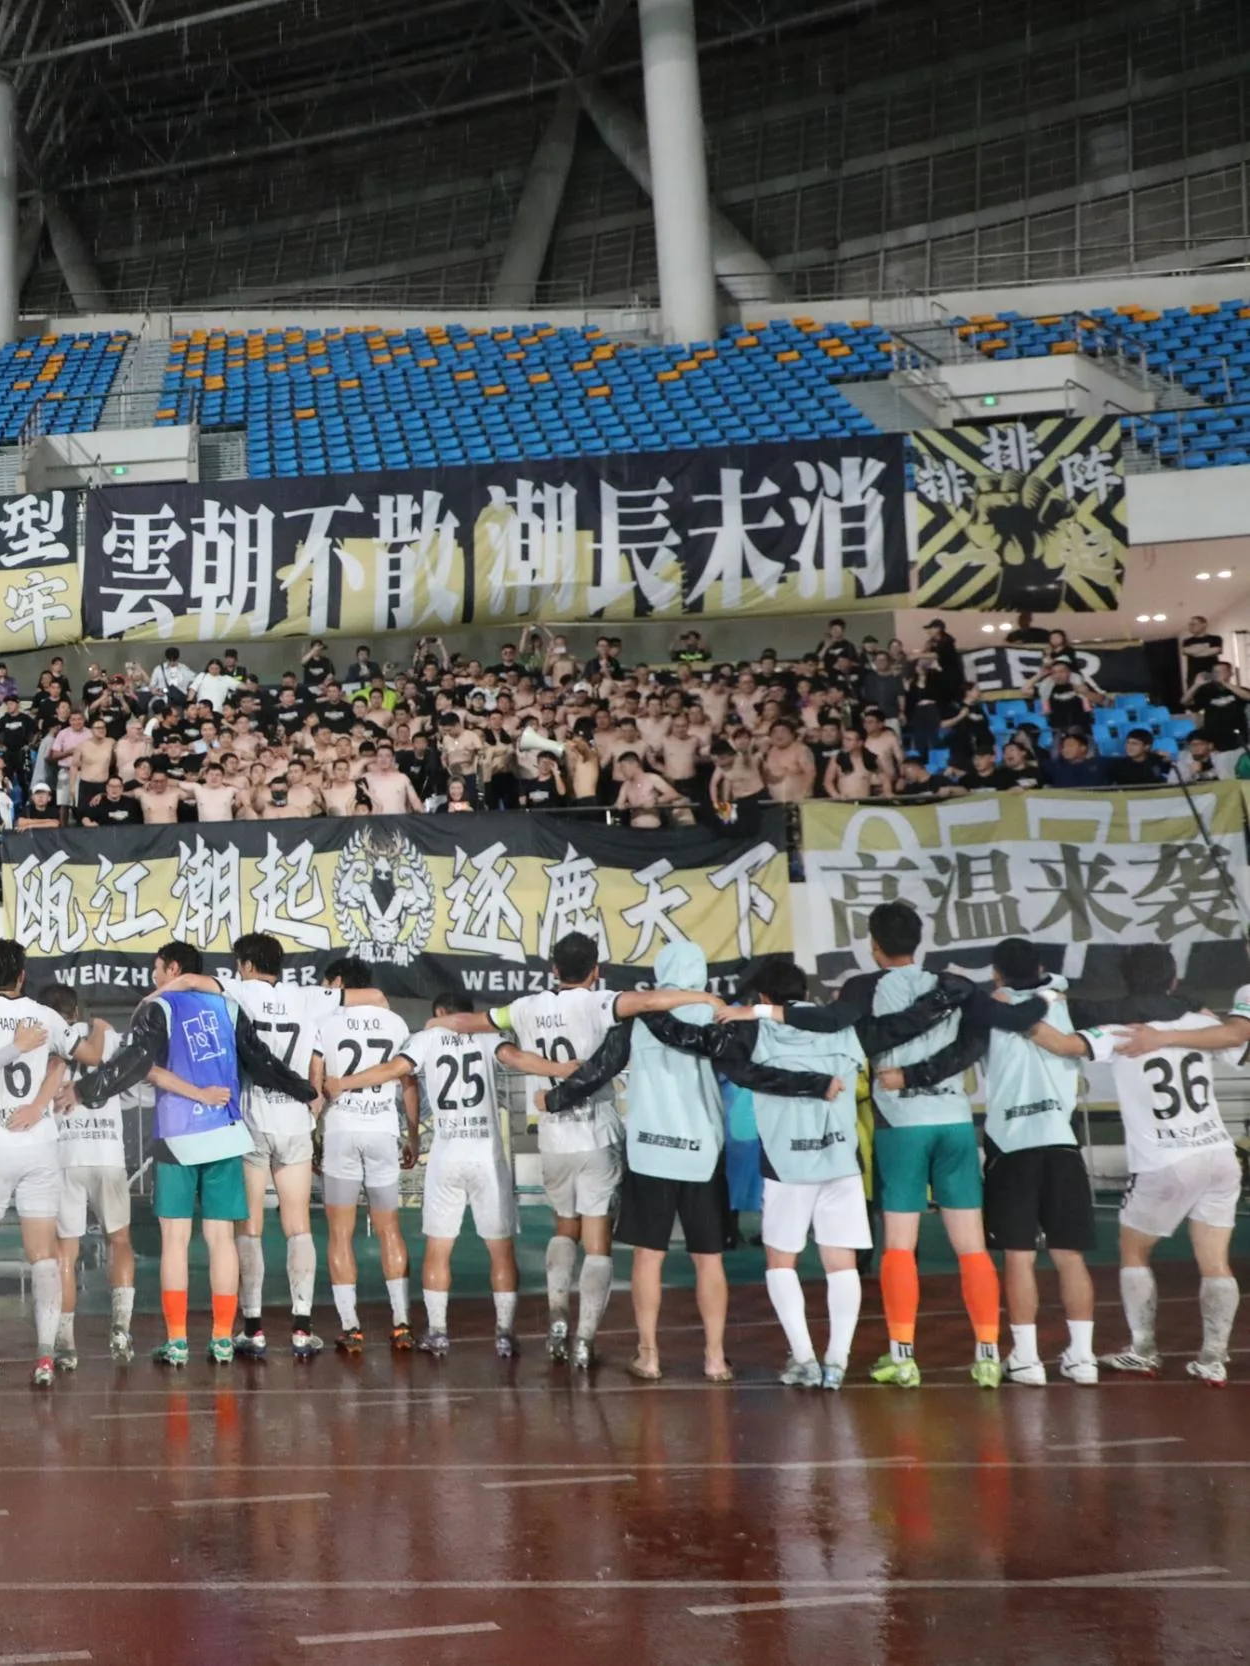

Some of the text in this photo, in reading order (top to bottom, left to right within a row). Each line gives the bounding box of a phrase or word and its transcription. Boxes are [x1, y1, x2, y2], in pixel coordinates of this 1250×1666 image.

[54, 963, 159, 987] WENZH
[3, 1058, 31, 1098] 6
[337, 1039, 394, 1093] 27
[436, 1051, 486, 1111] 25
[1143, 1052, 1210, 1120] 36
